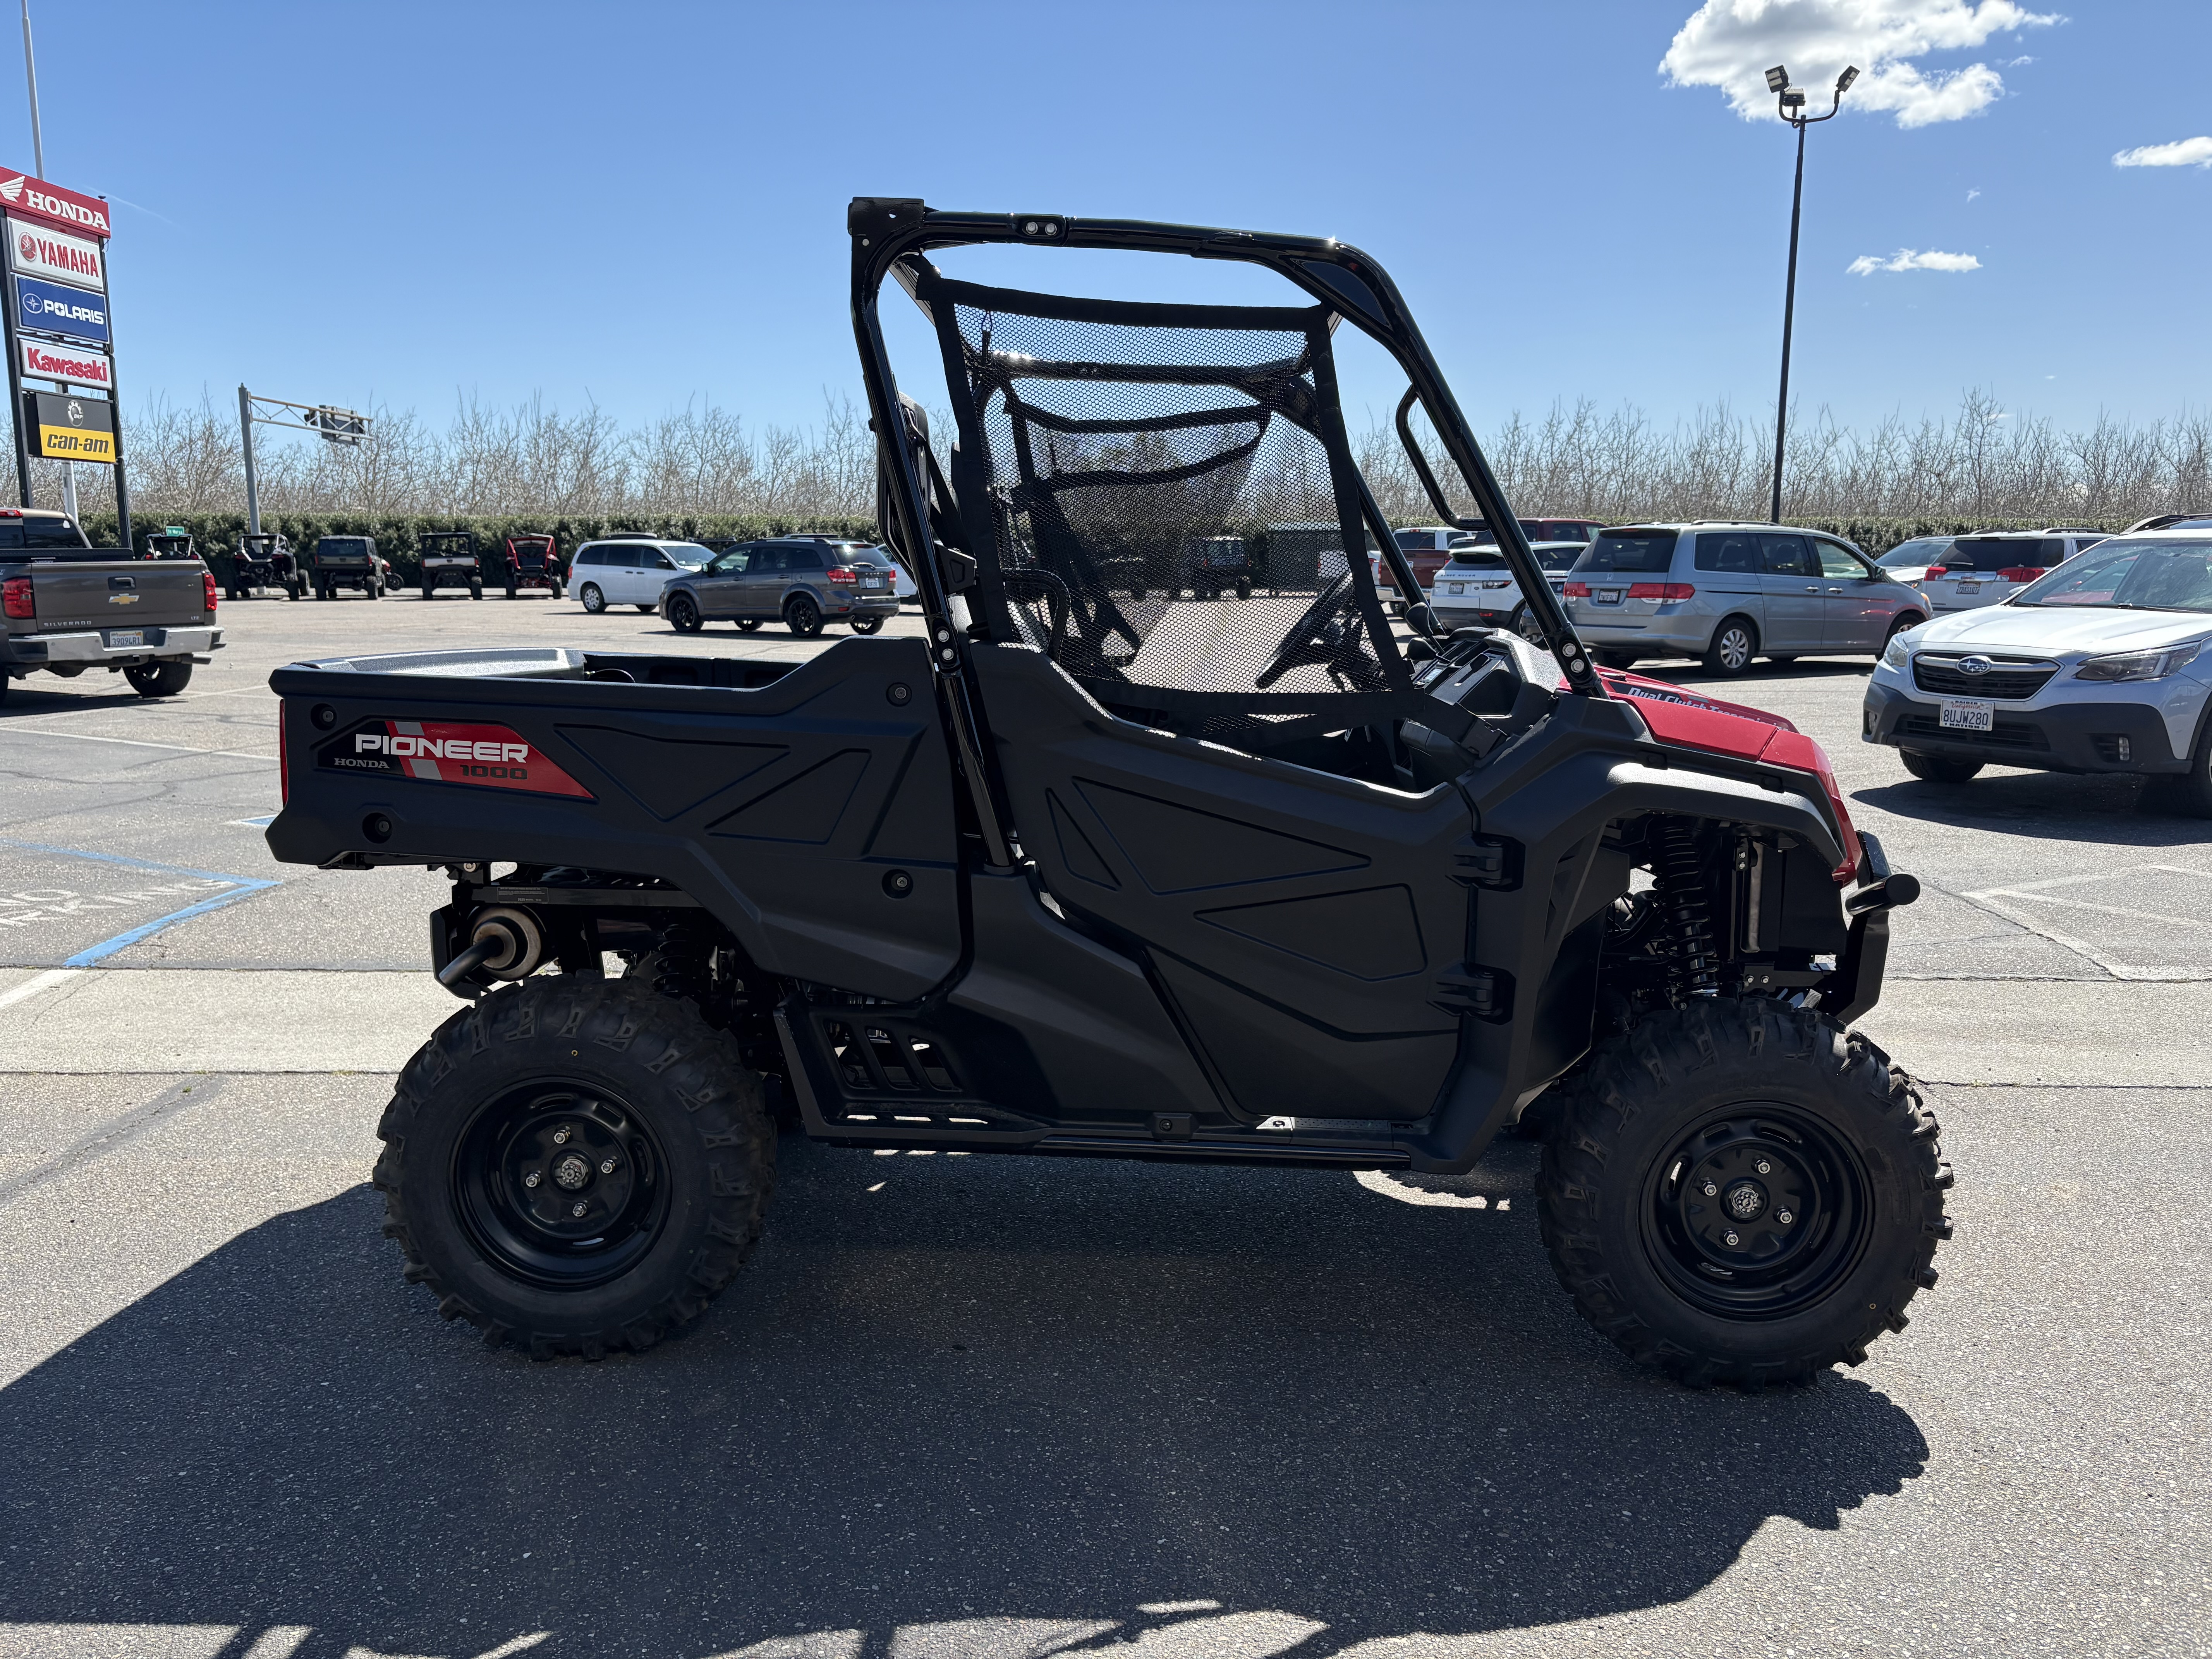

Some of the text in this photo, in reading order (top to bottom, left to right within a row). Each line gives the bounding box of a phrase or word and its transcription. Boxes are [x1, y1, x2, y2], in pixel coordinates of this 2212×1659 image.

[25, 189, 109, 231] HONDA
[37, 238, 99, 278] YAMAHA
[43, 299, 104, 325] POLARIS
[27, 347, 108, 381] Kawasaki
[47, 434, 109, 453] can-am
[1628, 687, 1662, 700] Dual
[1943, 709, 1989, 725] 8UJW280
[356, 734, 528, 763] PIONEER
[334, 758, 390, 769] HONDA
[460, 765, 528, 780] 1000
